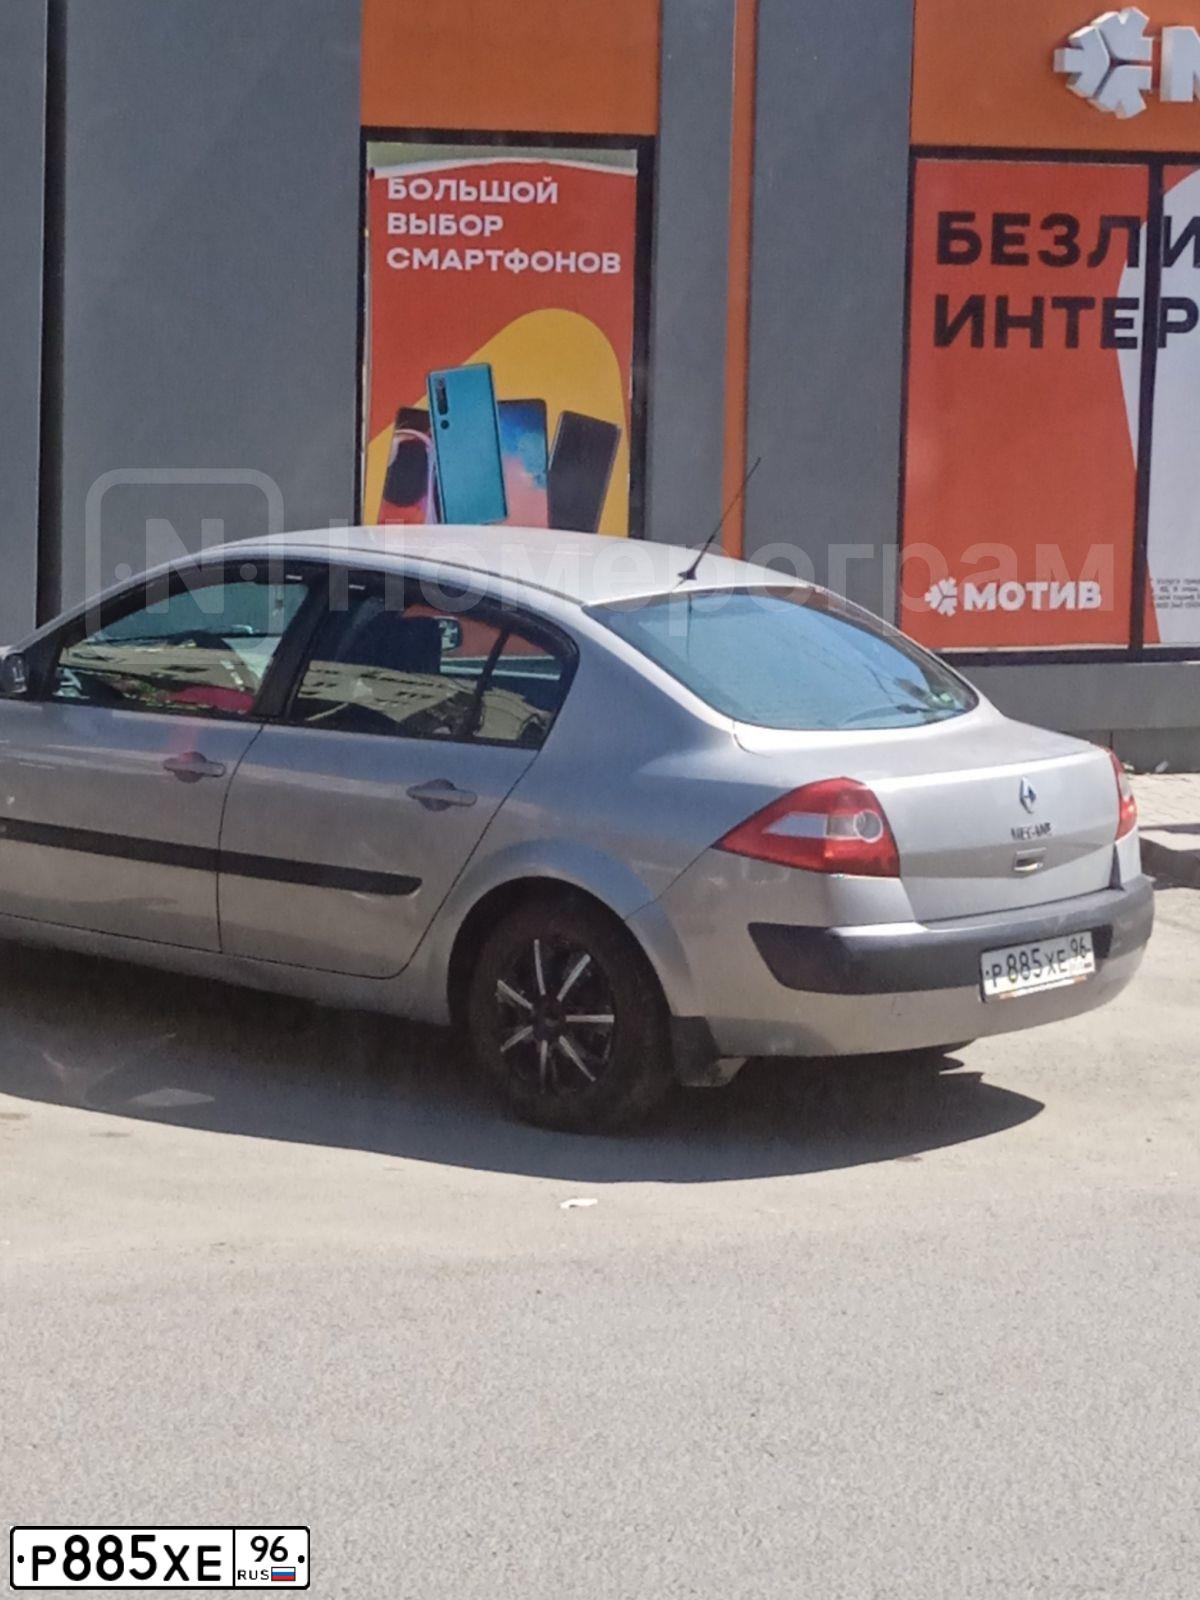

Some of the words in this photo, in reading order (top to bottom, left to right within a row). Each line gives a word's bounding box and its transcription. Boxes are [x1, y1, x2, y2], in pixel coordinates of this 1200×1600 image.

[388, 177, 558, 203] БОЛЬШОЙ
[387, 213, 504, 236] ВЫБОР
[936, 211, 1200, 268] БЕЗЛИ
[387, 247, 621, 274] СМАРТФОНОВ
[934, 294, 1200, 349] ИНТЕР
[963, 581, 1102, 611] МОТИВ
